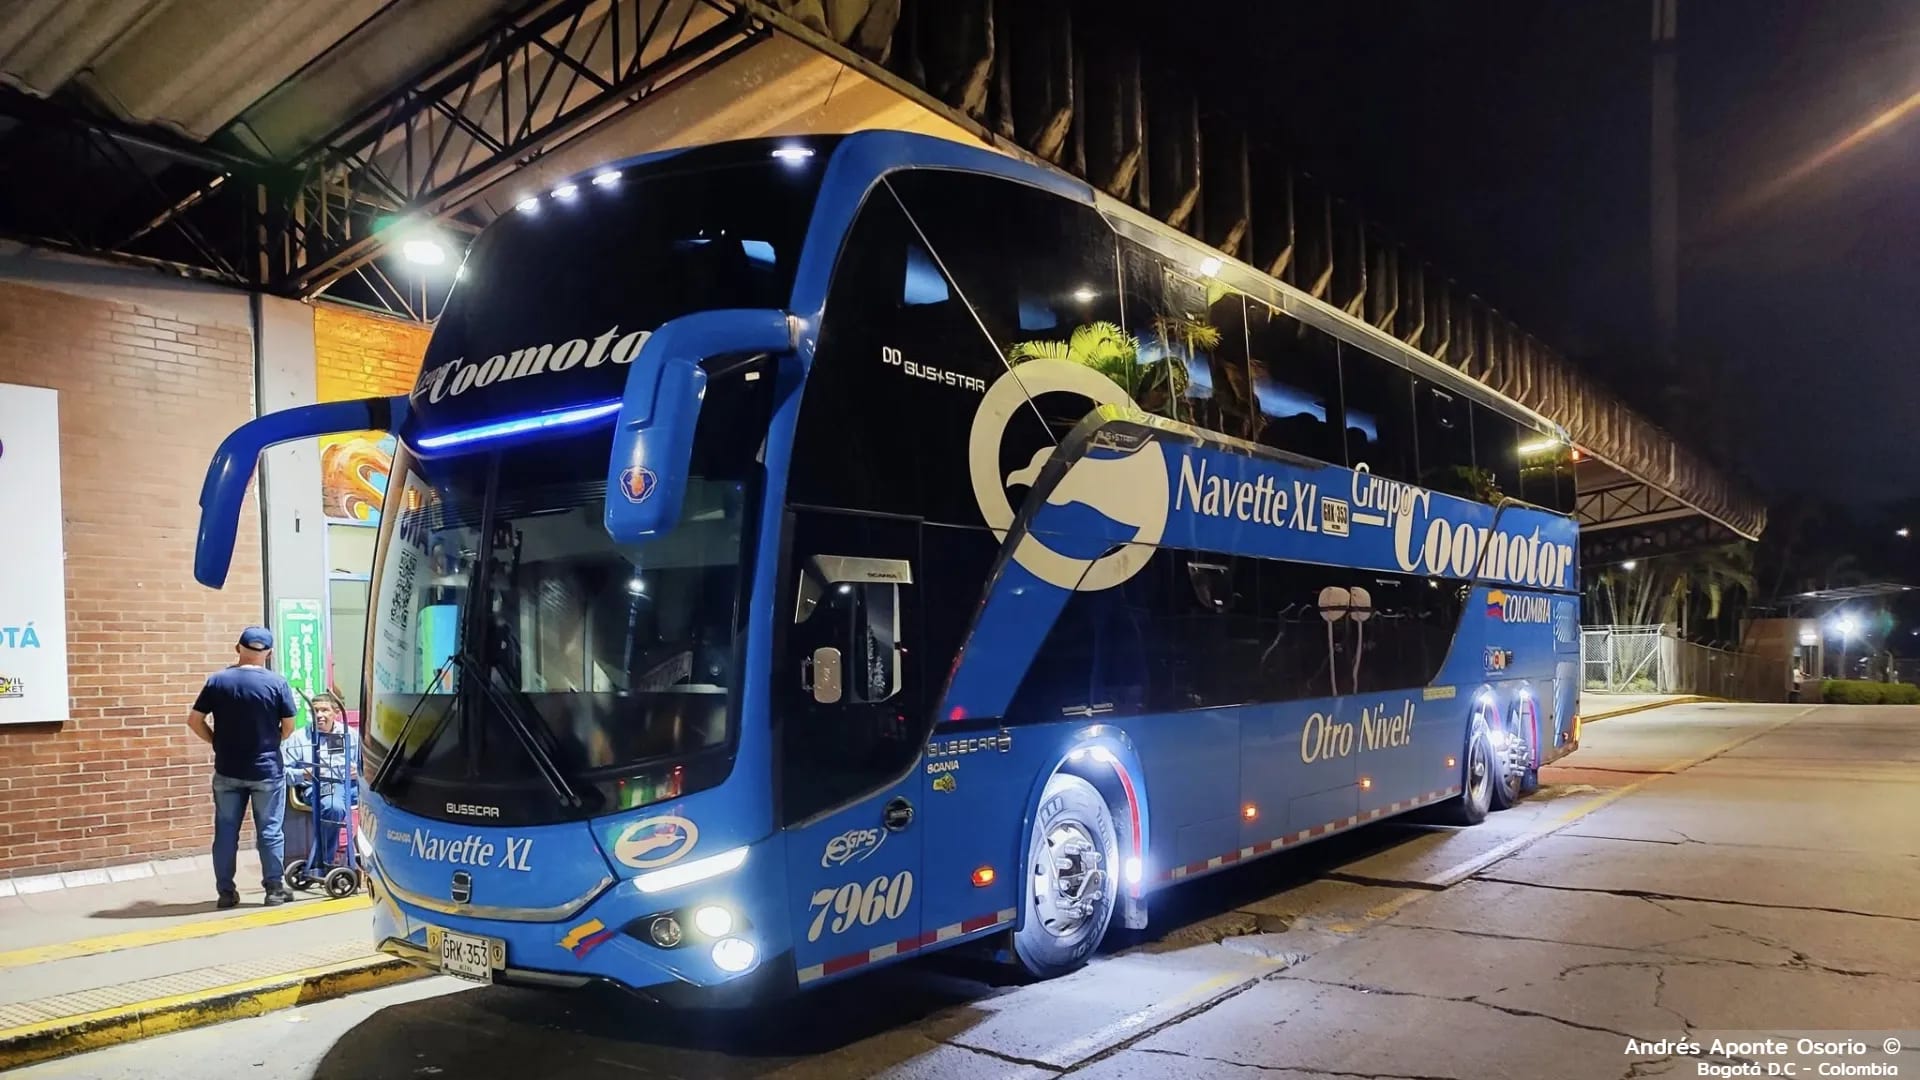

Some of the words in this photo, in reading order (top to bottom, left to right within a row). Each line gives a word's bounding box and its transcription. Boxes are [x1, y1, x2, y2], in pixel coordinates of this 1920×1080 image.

[429, 325, 653, 404] Coomoto
[882, 345, 902, 366] DD
[1175, 454, 1288, 527] Navette
[1288, 480, 1318, 533] XL
[1352, 462, 1413, 528] Grupo
[1394, 486, 1573, 588] Coomotor
[1502, 594, 1551, 624] COLOMBIA
[927, 737, 998, 758] BUSSCAR
[1301, 712, 1354, 763] Otro
[1358, 699, 1416, 752] Nivel!
[927, 760, 960, 775] SCANIA
[446, 803, 500, 818] BUSSCAR
[410, 828, 494, 867] Navette
[498, 836, 534, 872] XL
[807, 870, 913, 942] 7960
